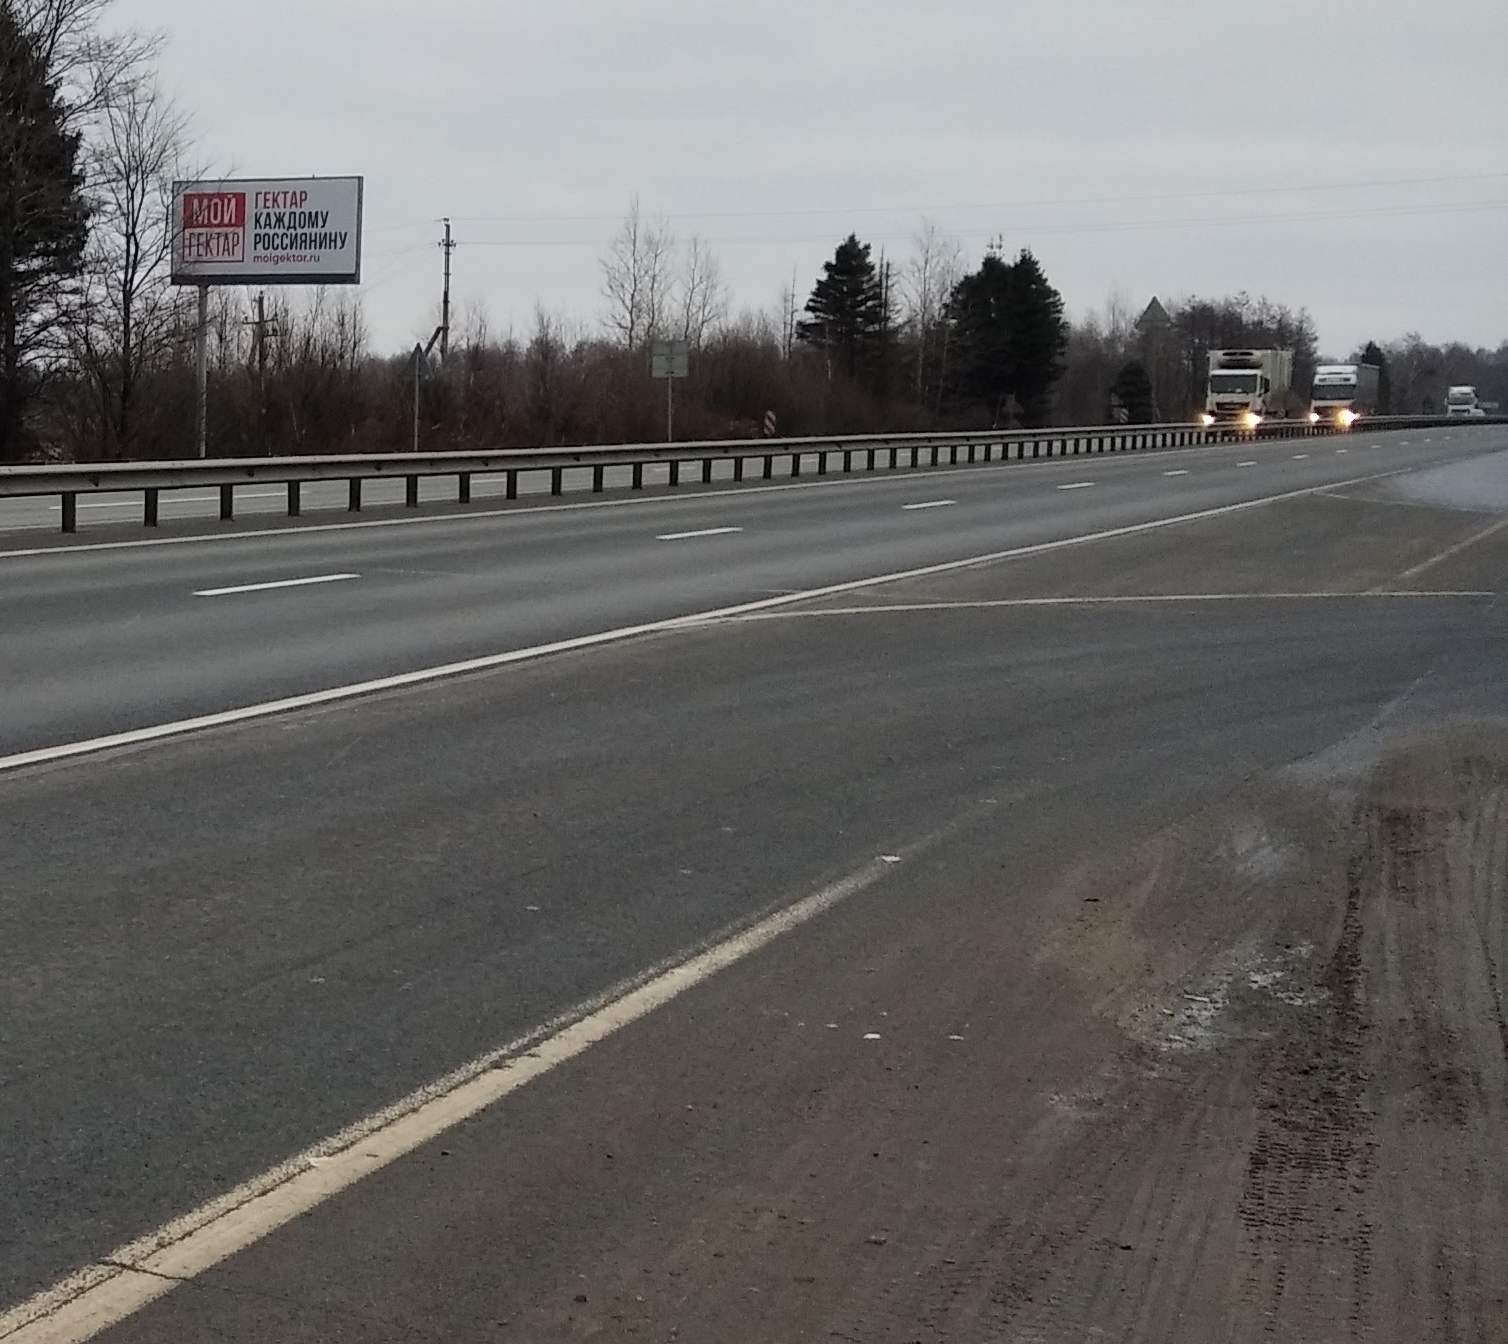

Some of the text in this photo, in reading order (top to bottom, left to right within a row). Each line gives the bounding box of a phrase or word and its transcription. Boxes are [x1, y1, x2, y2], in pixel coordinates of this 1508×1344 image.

[192, 194, 237, 225] МОЙ
[255, 190, 308, 209] ГЕКТАР
[254, 211, 329, 231] КАЖДОМУ
[188, 231, 240, 257] ГЕКТАР
[253, 231, 348, 251] РОССИЯНИНУ
[253, 253, 320, 265] moigektar.ru
